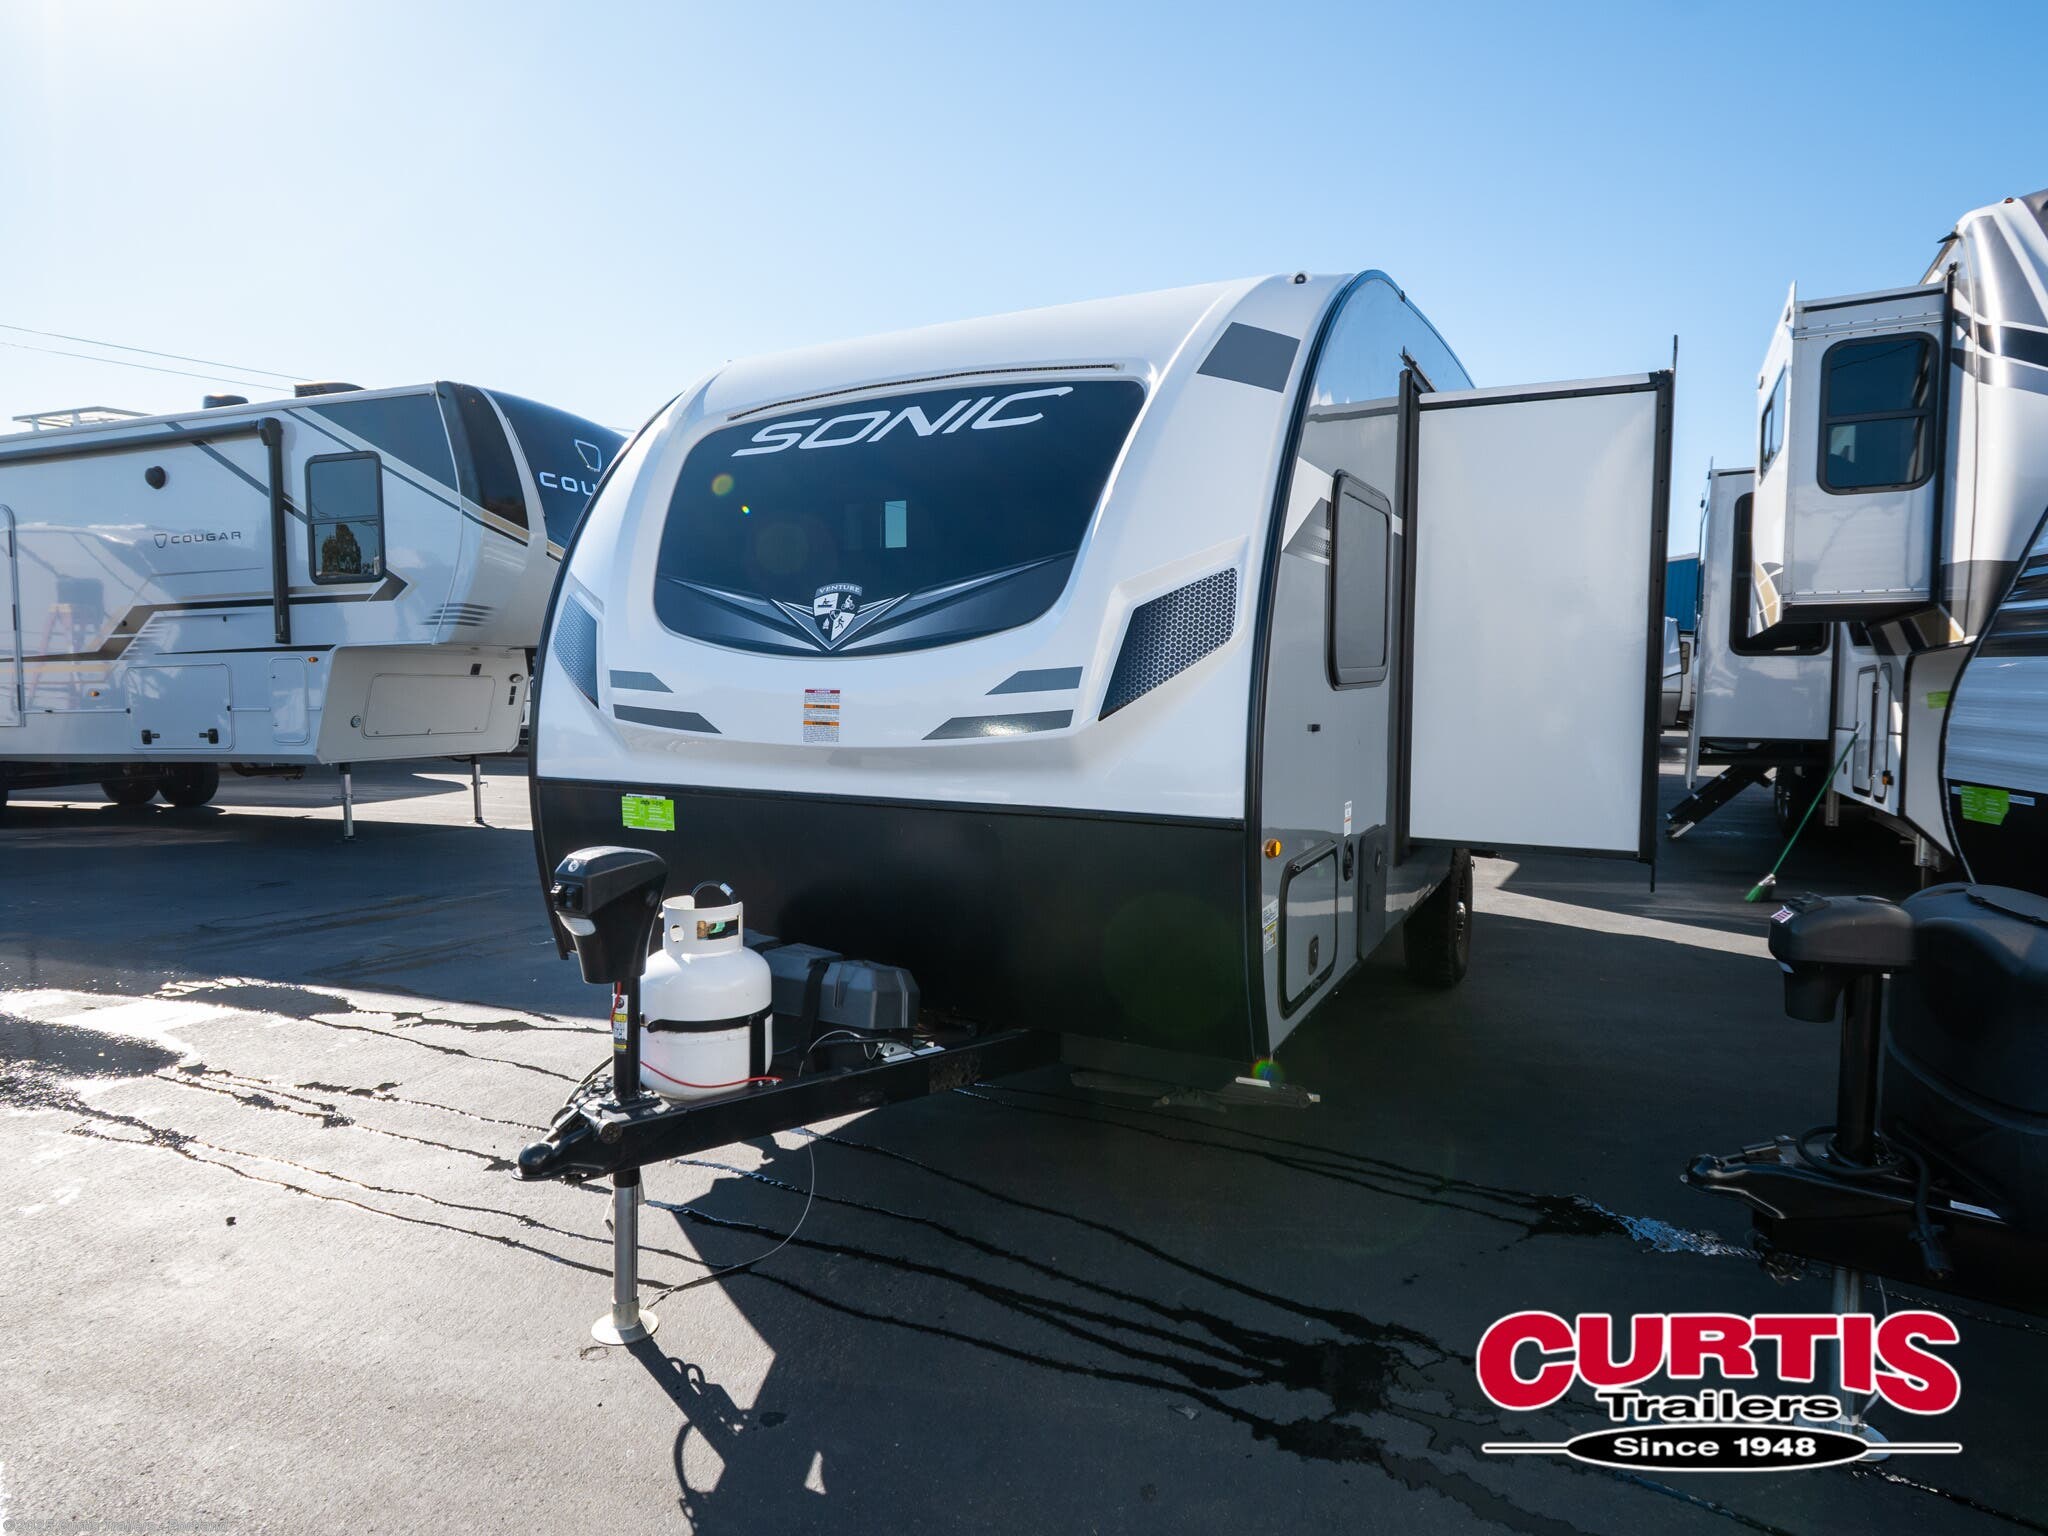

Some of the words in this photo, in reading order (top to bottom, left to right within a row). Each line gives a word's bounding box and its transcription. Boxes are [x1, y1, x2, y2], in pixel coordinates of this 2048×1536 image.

[731, 386, 1073, 457] SONIC
[171, 531, 242, 544] COUGAR
[819, 584, 860, 593] VENTURE
